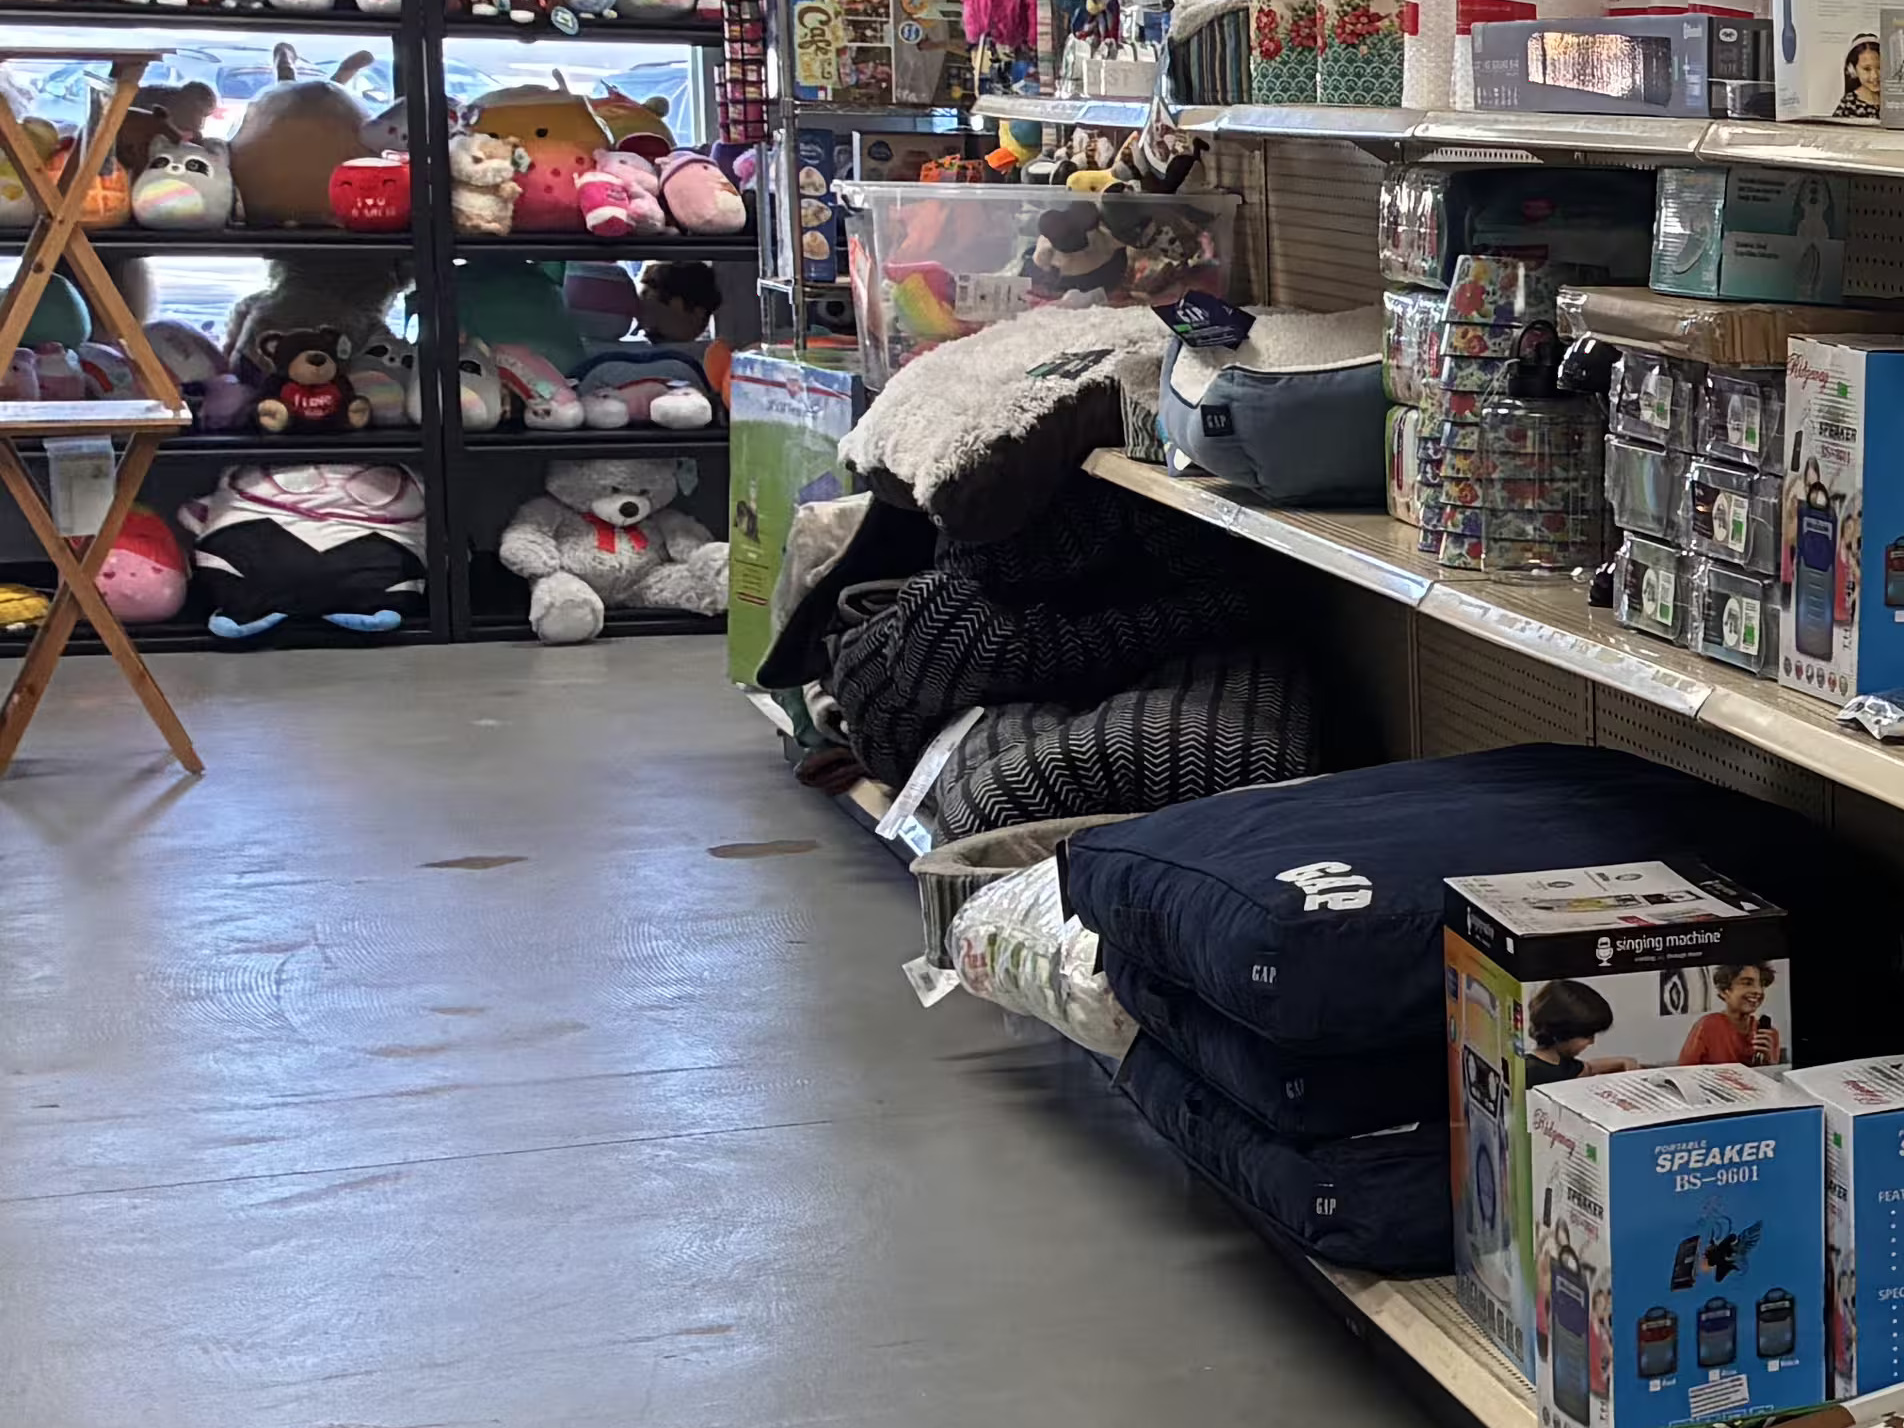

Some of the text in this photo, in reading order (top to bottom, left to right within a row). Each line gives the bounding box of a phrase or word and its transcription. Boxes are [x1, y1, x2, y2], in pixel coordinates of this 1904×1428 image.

[1275, 860, 1374, 911] GAP
[1615, 929, 1722, 954] singing machine
[1251, 964, 1277, 985] GAP
[1654, 1139, 1777, 1174] SPEAKER
[1655, 1139, 1707, 1154] PORTABLE
